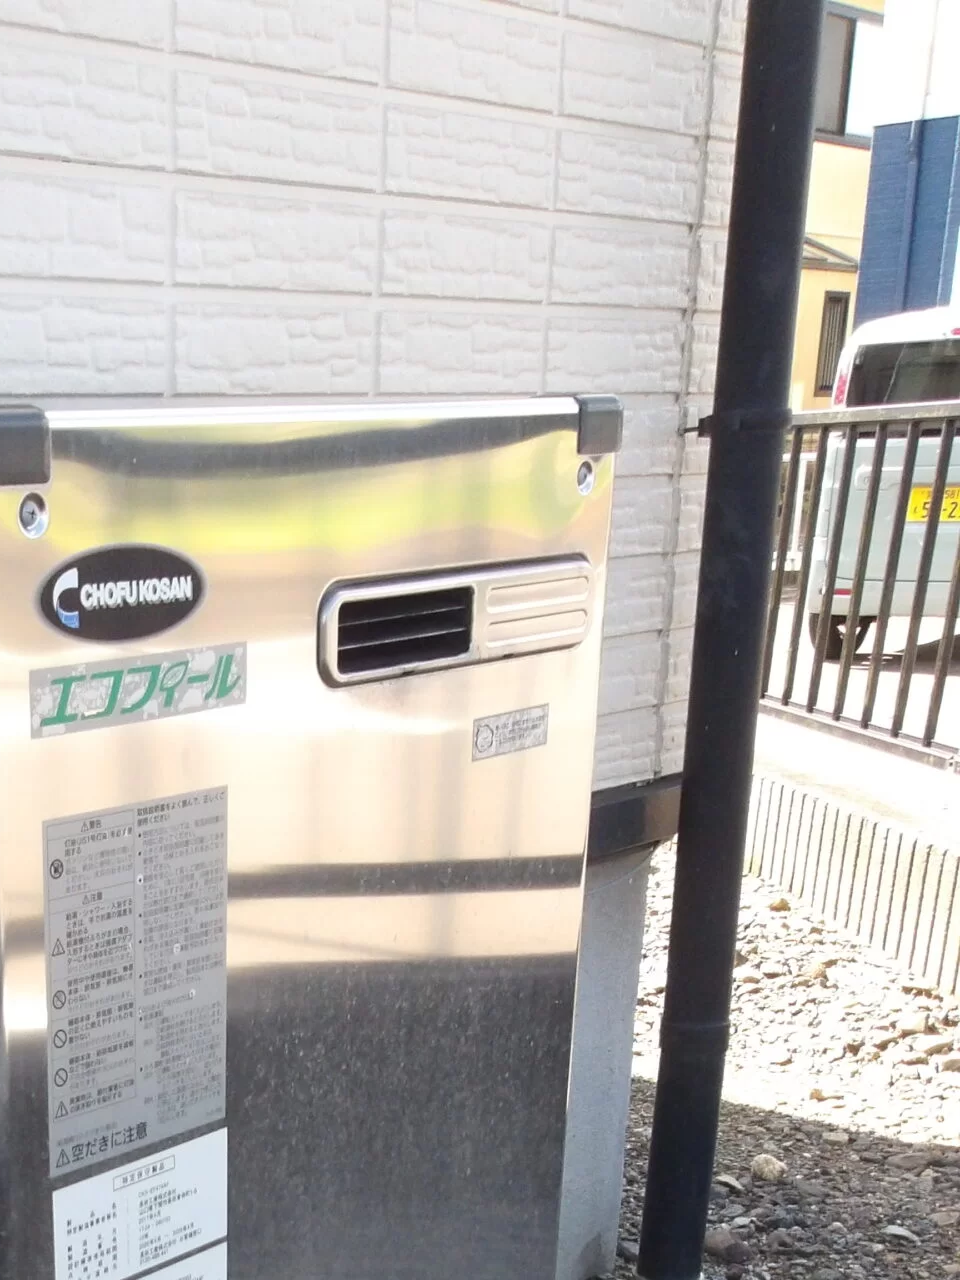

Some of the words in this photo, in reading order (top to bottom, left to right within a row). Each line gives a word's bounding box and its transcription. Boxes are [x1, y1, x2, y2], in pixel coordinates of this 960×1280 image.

[80, 579, 137, 610] CHOFU
[139, 575, 193, 604] KOSAN
[40, 654, 241, 727] エコフィール
[72, 1121, 147, 1163] 空だきに注意
